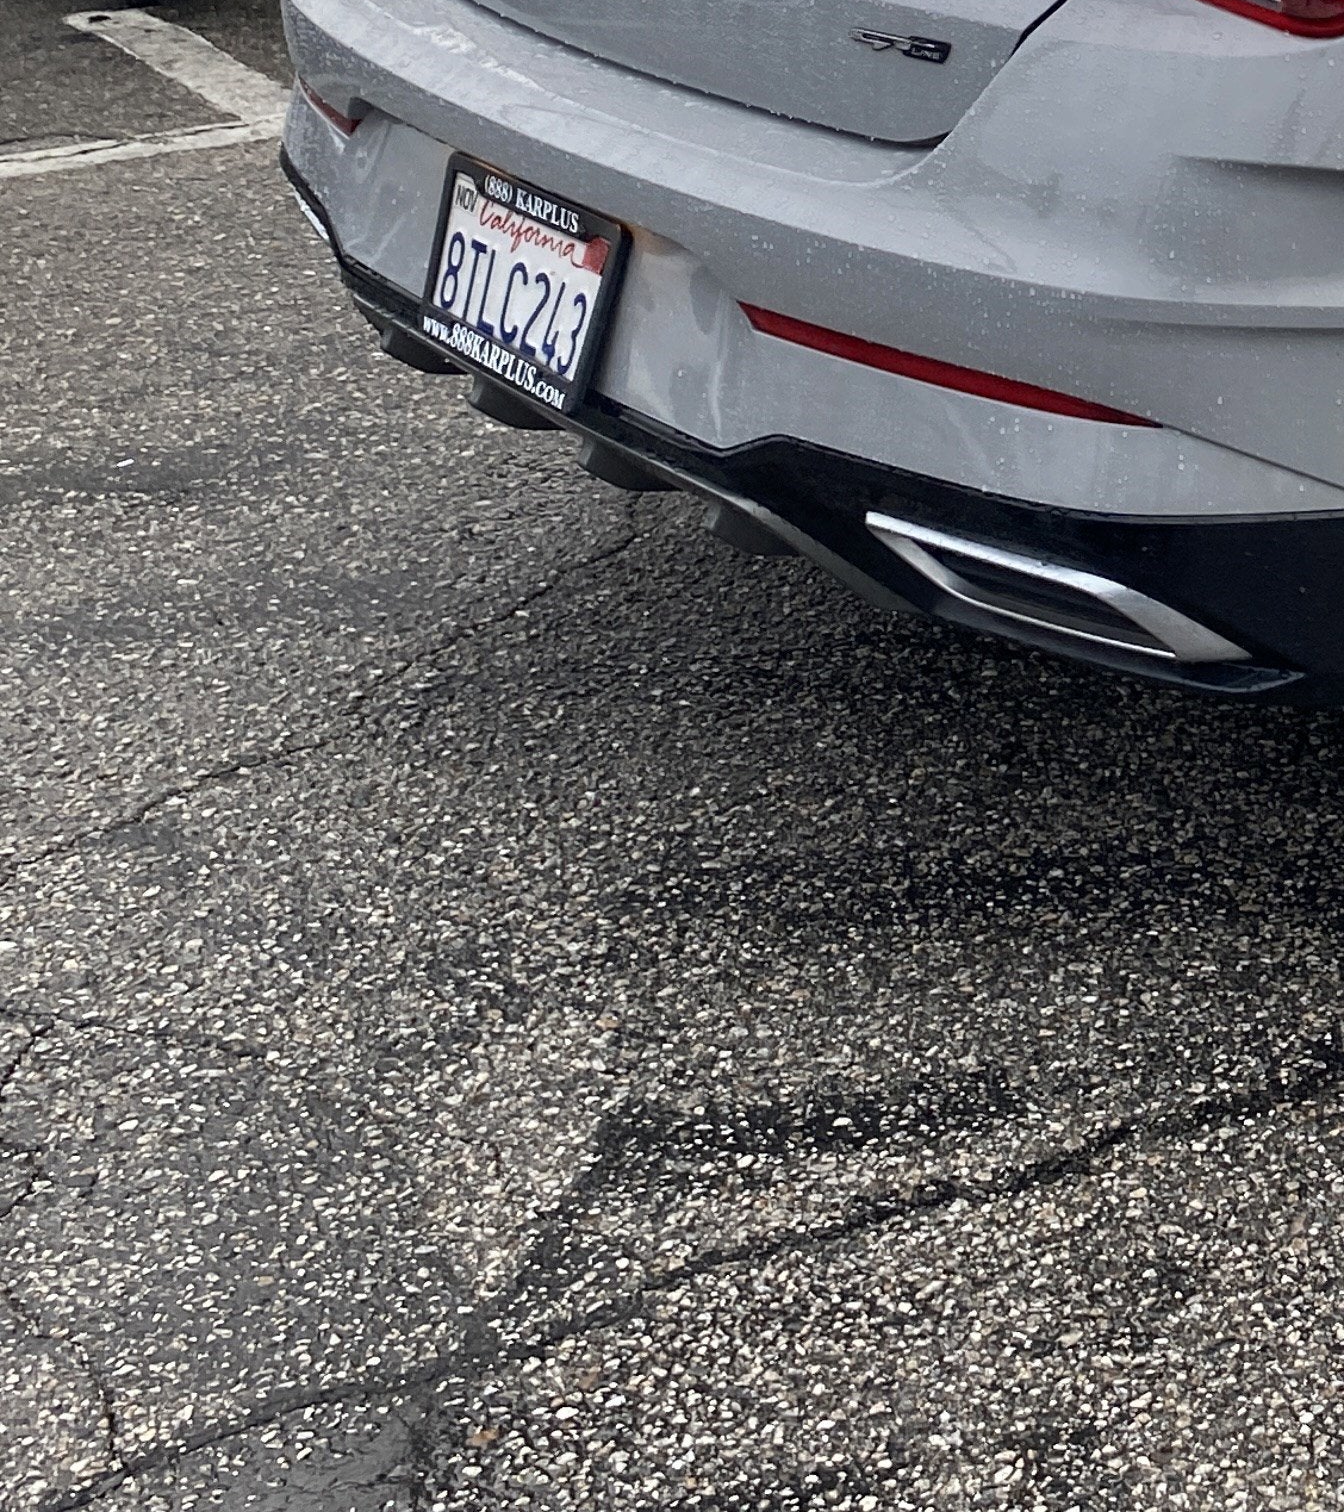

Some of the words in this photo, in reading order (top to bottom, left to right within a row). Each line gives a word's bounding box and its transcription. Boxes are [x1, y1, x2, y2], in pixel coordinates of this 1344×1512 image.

[455, 185, 478, 214] NOV
[484, 175, 513, 204] (888)
[515, 187, 580, 234] KARPLUS
[479, 199, 584, 269] California
[440, 231, 588, 376] 8TLC243
